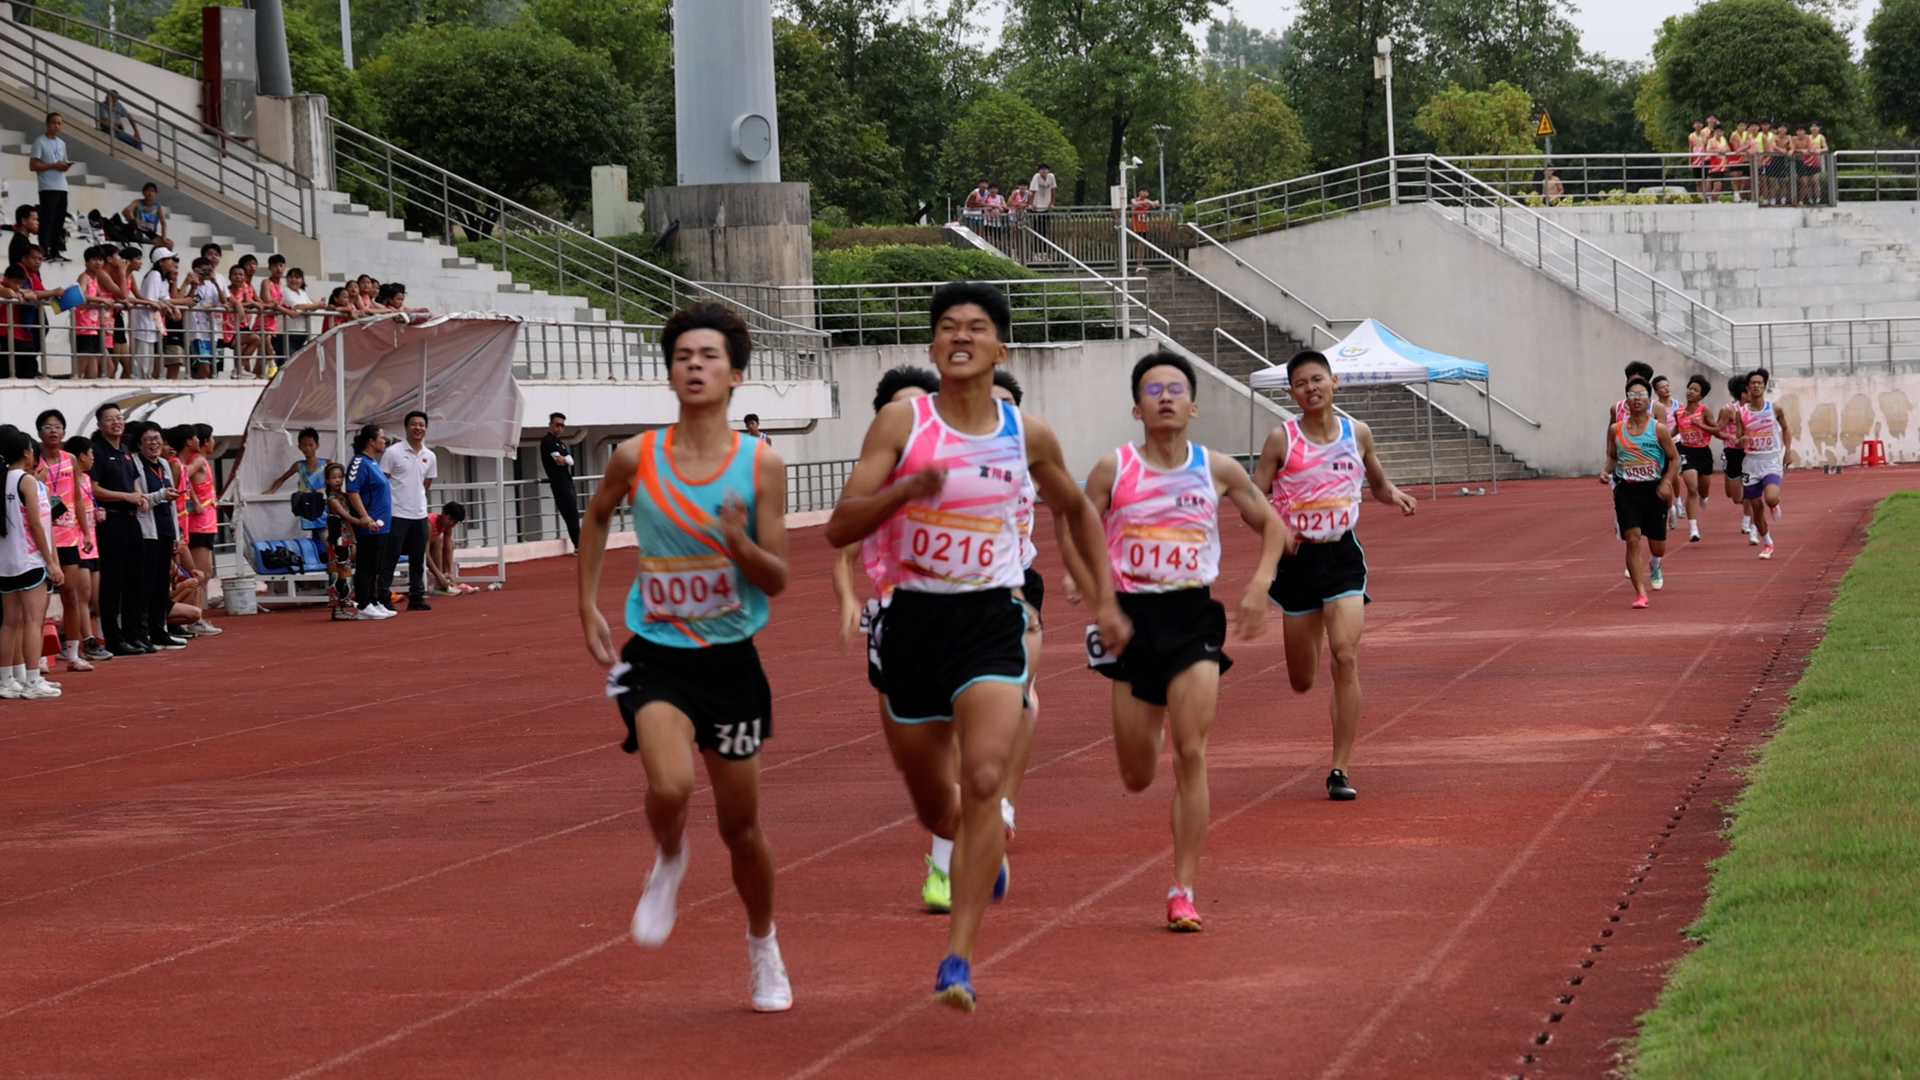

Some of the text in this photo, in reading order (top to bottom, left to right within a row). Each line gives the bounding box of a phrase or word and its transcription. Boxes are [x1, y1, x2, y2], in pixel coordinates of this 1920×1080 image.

[1297, 511, 1350, 532] 0214
[912, 528, 994, 567] 0216
[1129, 543, 1199, 571] 0143
[649, 573, 731, 605] 0004
[1086, 630, 1107, 659] 6
